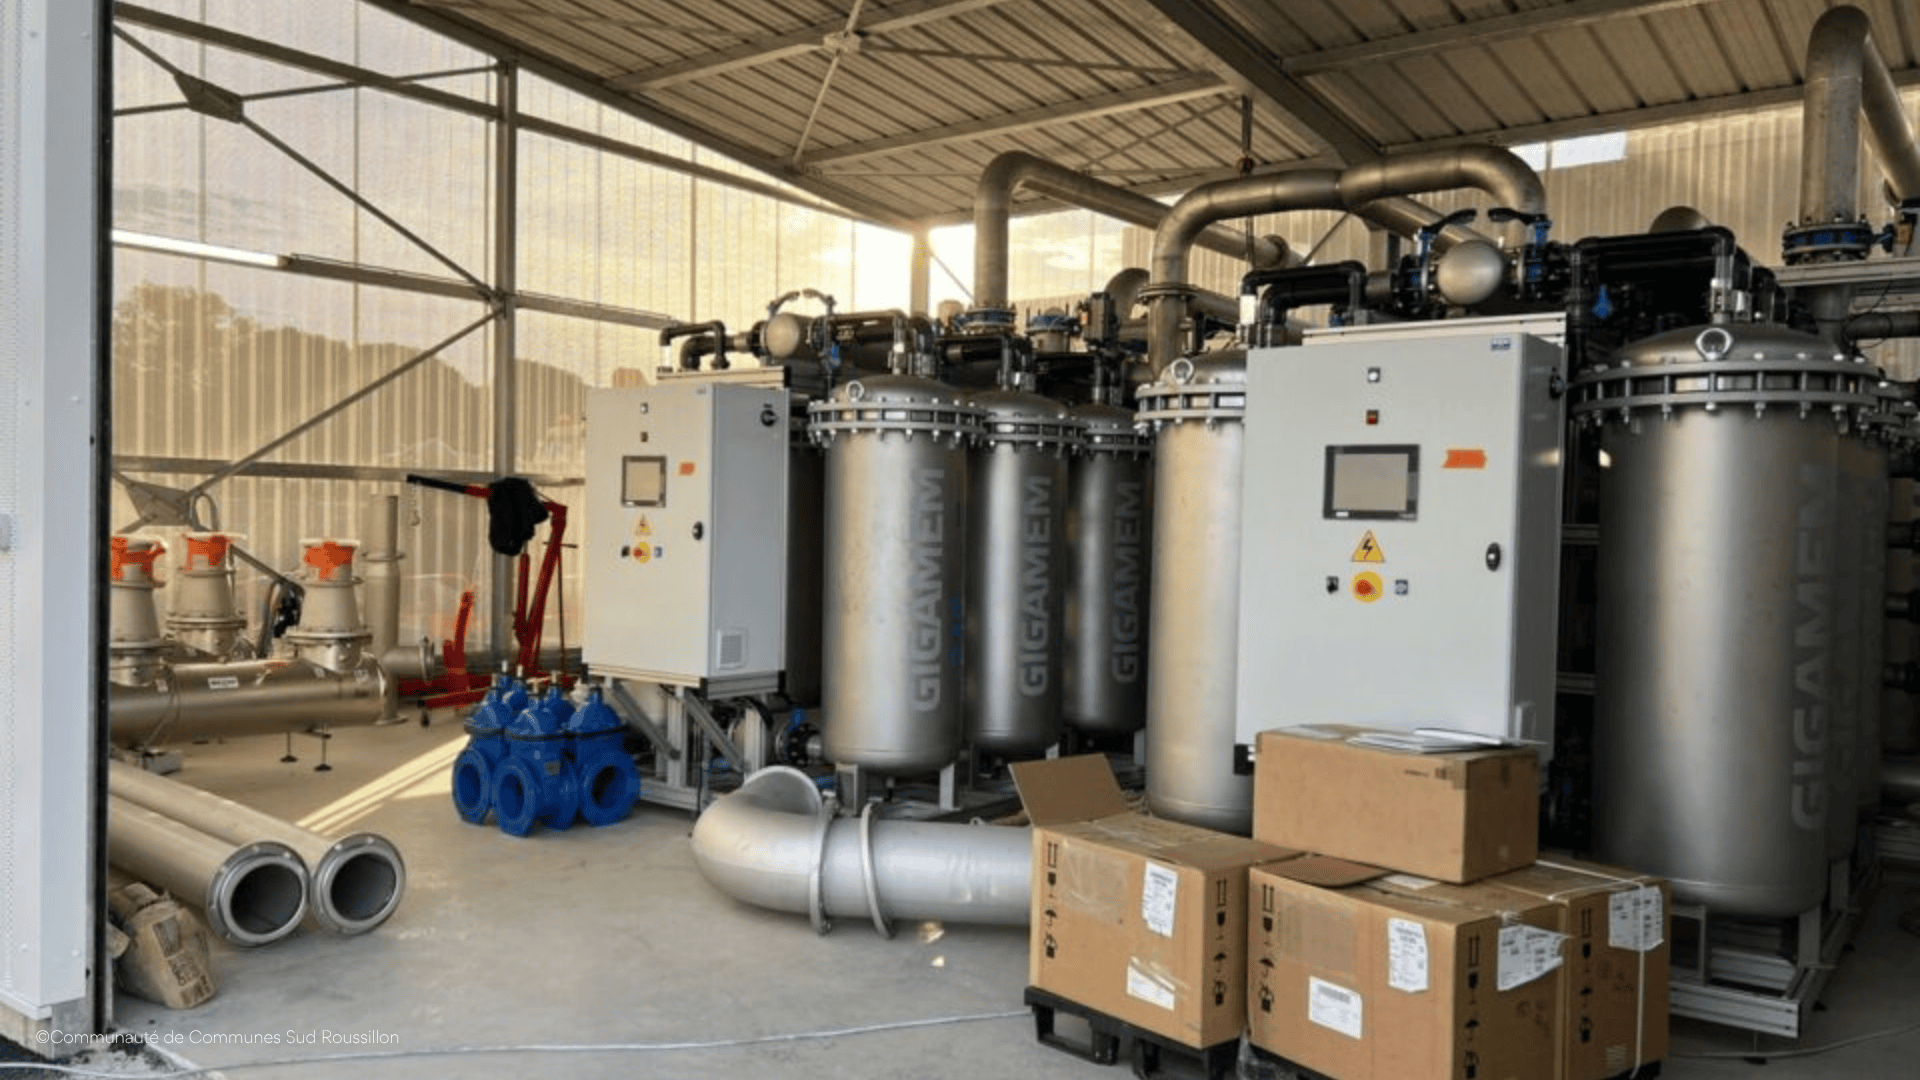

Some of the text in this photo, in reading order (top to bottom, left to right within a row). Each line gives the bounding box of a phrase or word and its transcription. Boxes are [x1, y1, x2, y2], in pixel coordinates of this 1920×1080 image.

[910, 468, 945, 712] GIGAMEM
[1018, 475, 1052, 697] GIGAMEM
[1111, 481, 1141, 683] GIGAMEM
